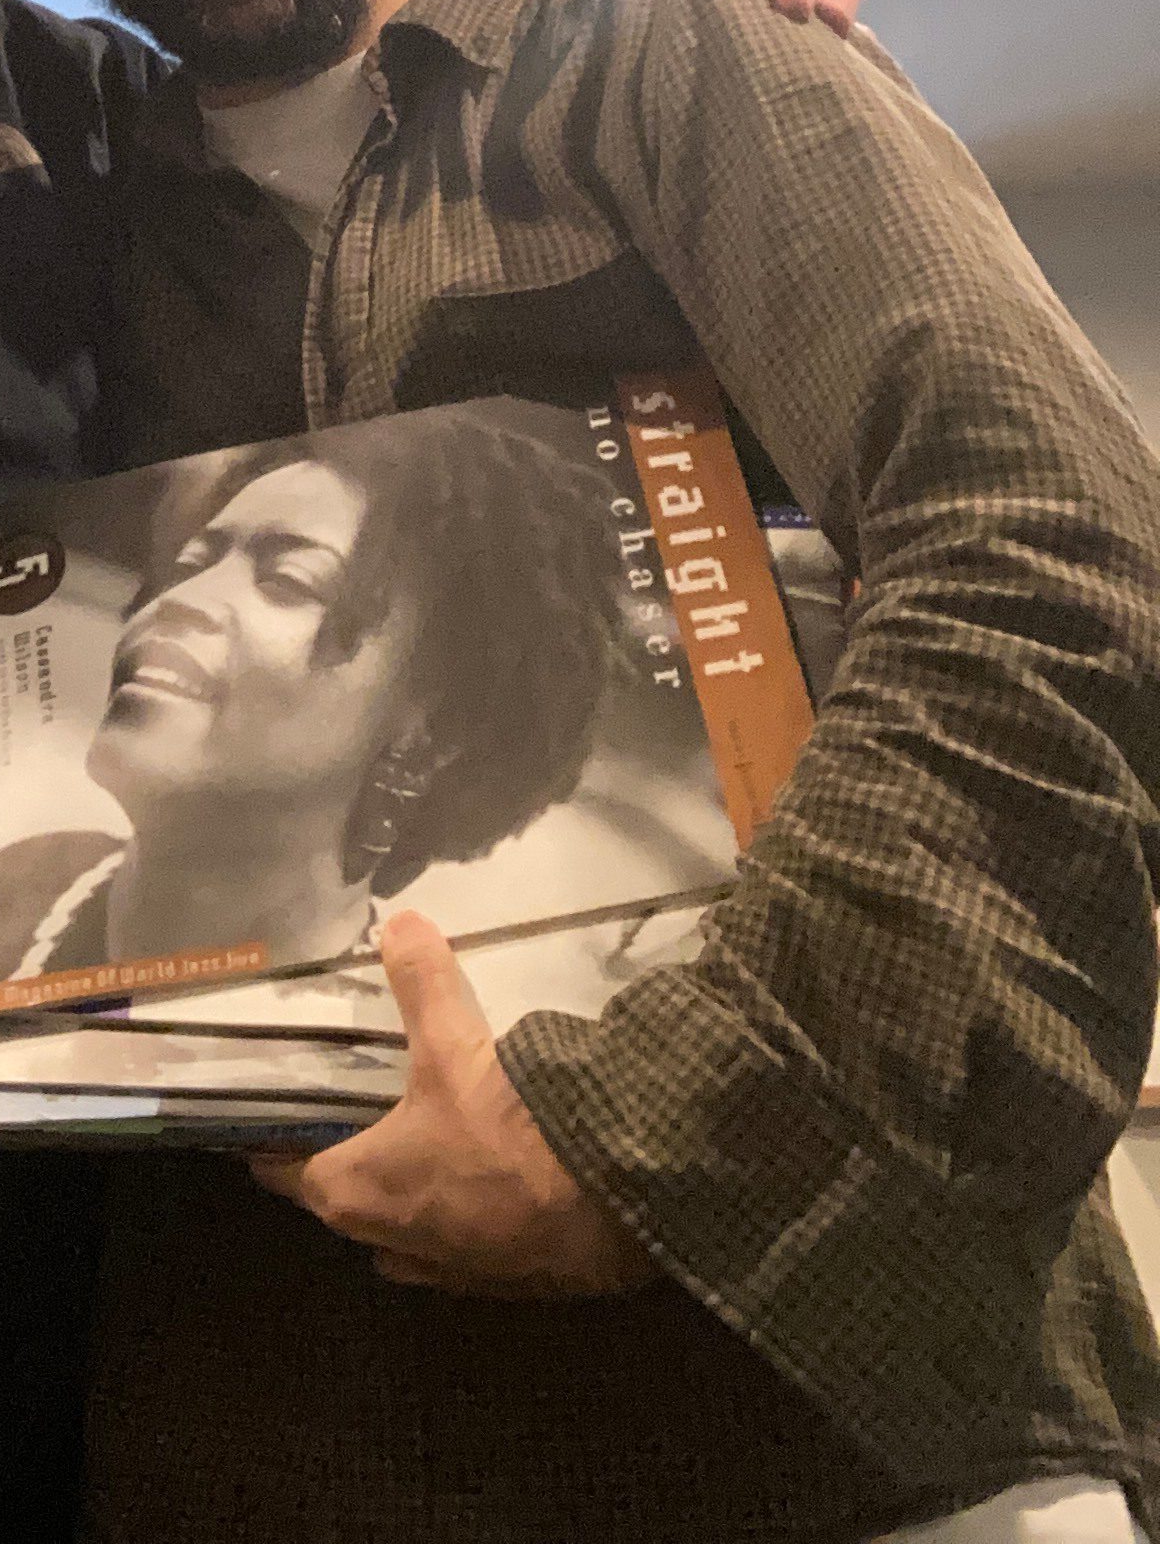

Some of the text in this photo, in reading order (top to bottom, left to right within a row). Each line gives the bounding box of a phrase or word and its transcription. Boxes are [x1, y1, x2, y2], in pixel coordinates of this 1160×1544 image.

[586, 406, 681, 689] no chaser
[631, 390, 765, 678] straight
[120, 960, 176, 984] World
